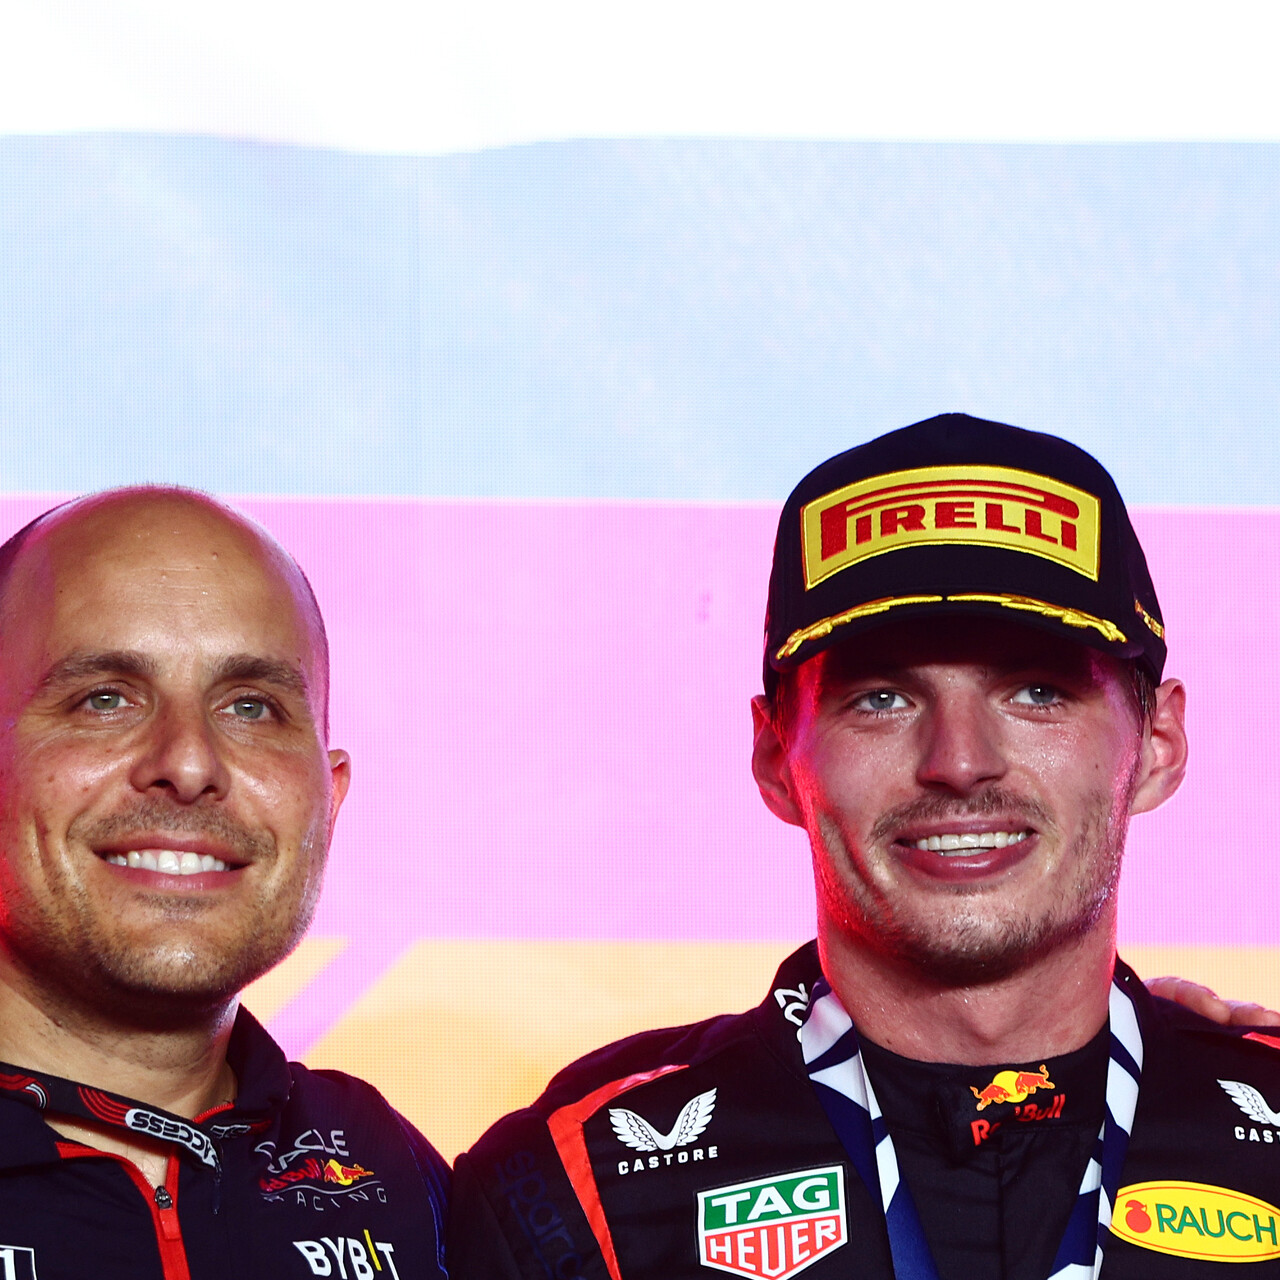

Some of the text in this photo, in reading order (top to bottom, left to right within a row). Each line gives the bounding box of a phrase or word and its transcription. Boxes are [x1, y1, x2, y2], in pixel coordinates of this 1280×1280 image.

[820, 480, 1079, 561] PIRELLI
[617, 1147, 719, 1176] CASTORE
[710, 1178, 831, 1220] TAG
[1156, 1203, 1277, 1246] RAUCH
[707, 1219, 838, 1278] HEUER
